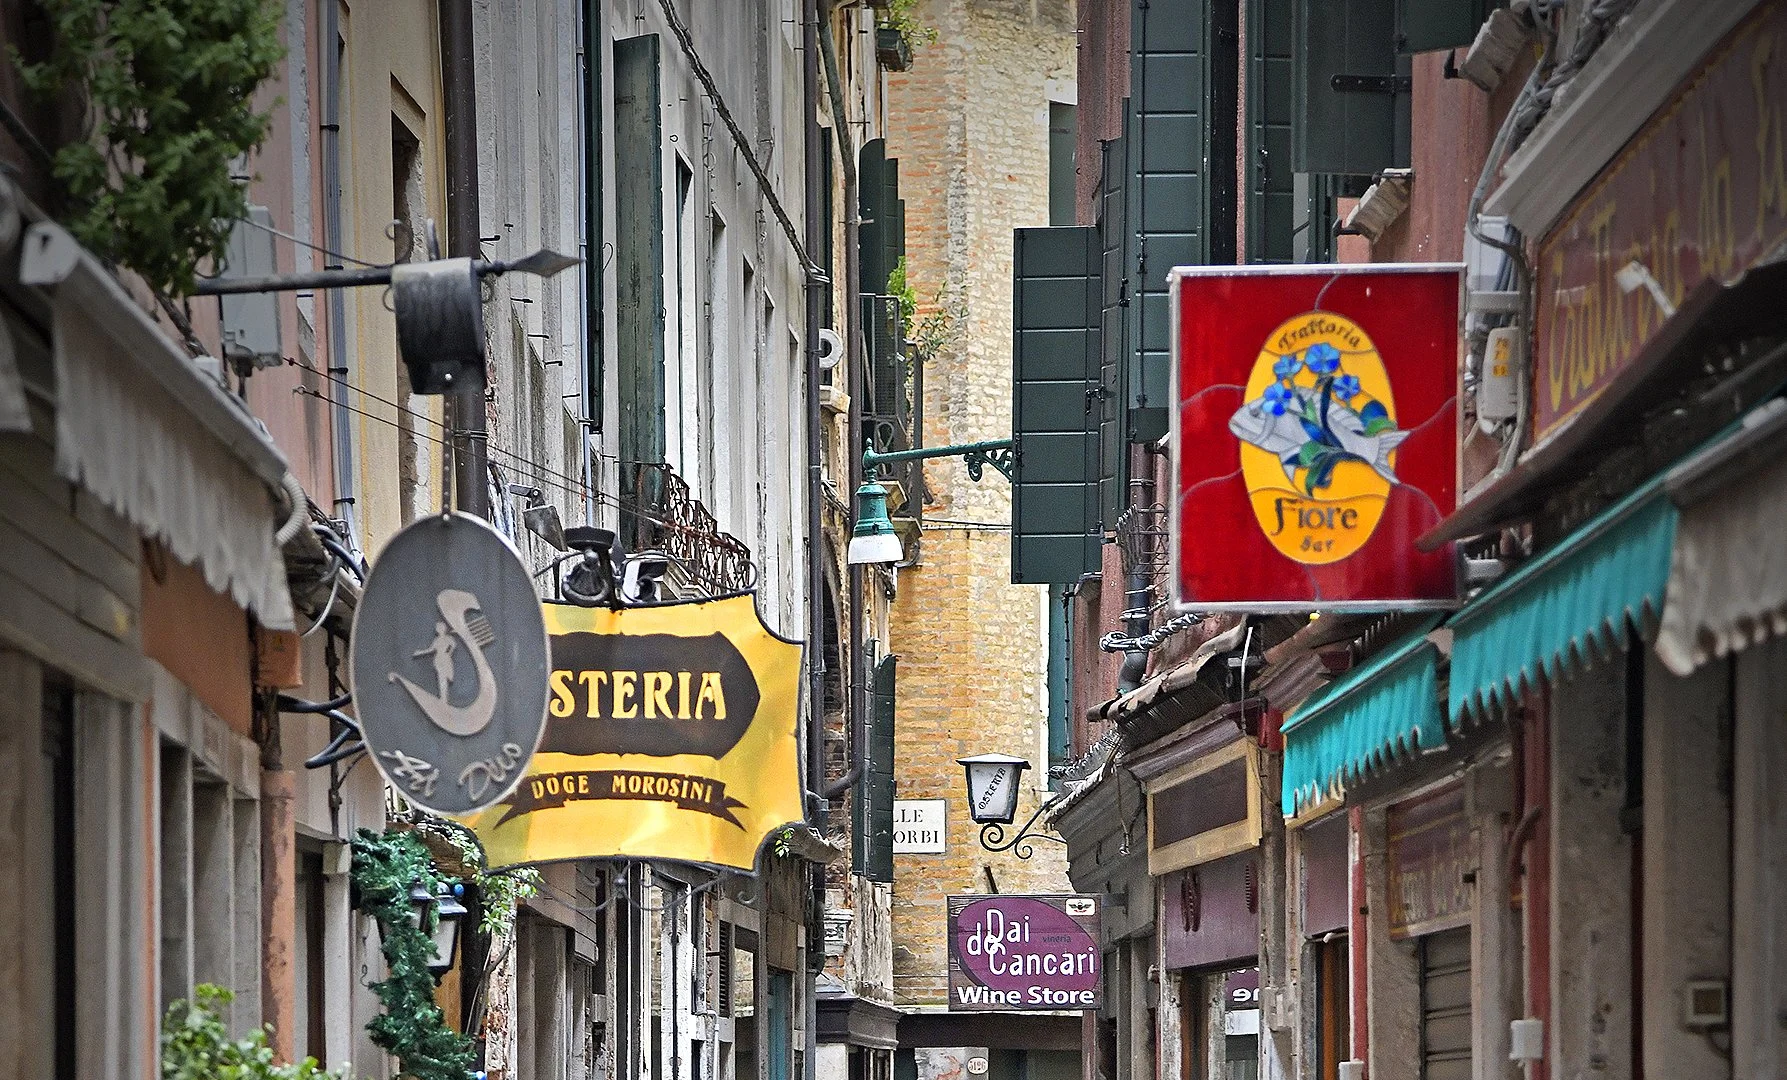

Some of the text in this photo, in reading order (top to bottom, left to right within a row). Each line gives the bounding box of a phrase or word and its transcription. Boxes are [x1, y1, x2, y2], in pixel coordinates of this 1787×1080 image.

[1278, 318, 1361, 349] Trattoria
[1271, 497, 1358, 536] Fiore
[549, 669, 727, 720] STERIA
[531, 774, 713, 803] DOGE MOROSINI
[978, 767, 1006, 810] OSTERIA
[894, 831, 939, 844] ORBI
[987, 908, 1030, 944] Dai
[988, 941, 1095, 976] Cancari
[957, 986, 1095, 1004] Wine Store
